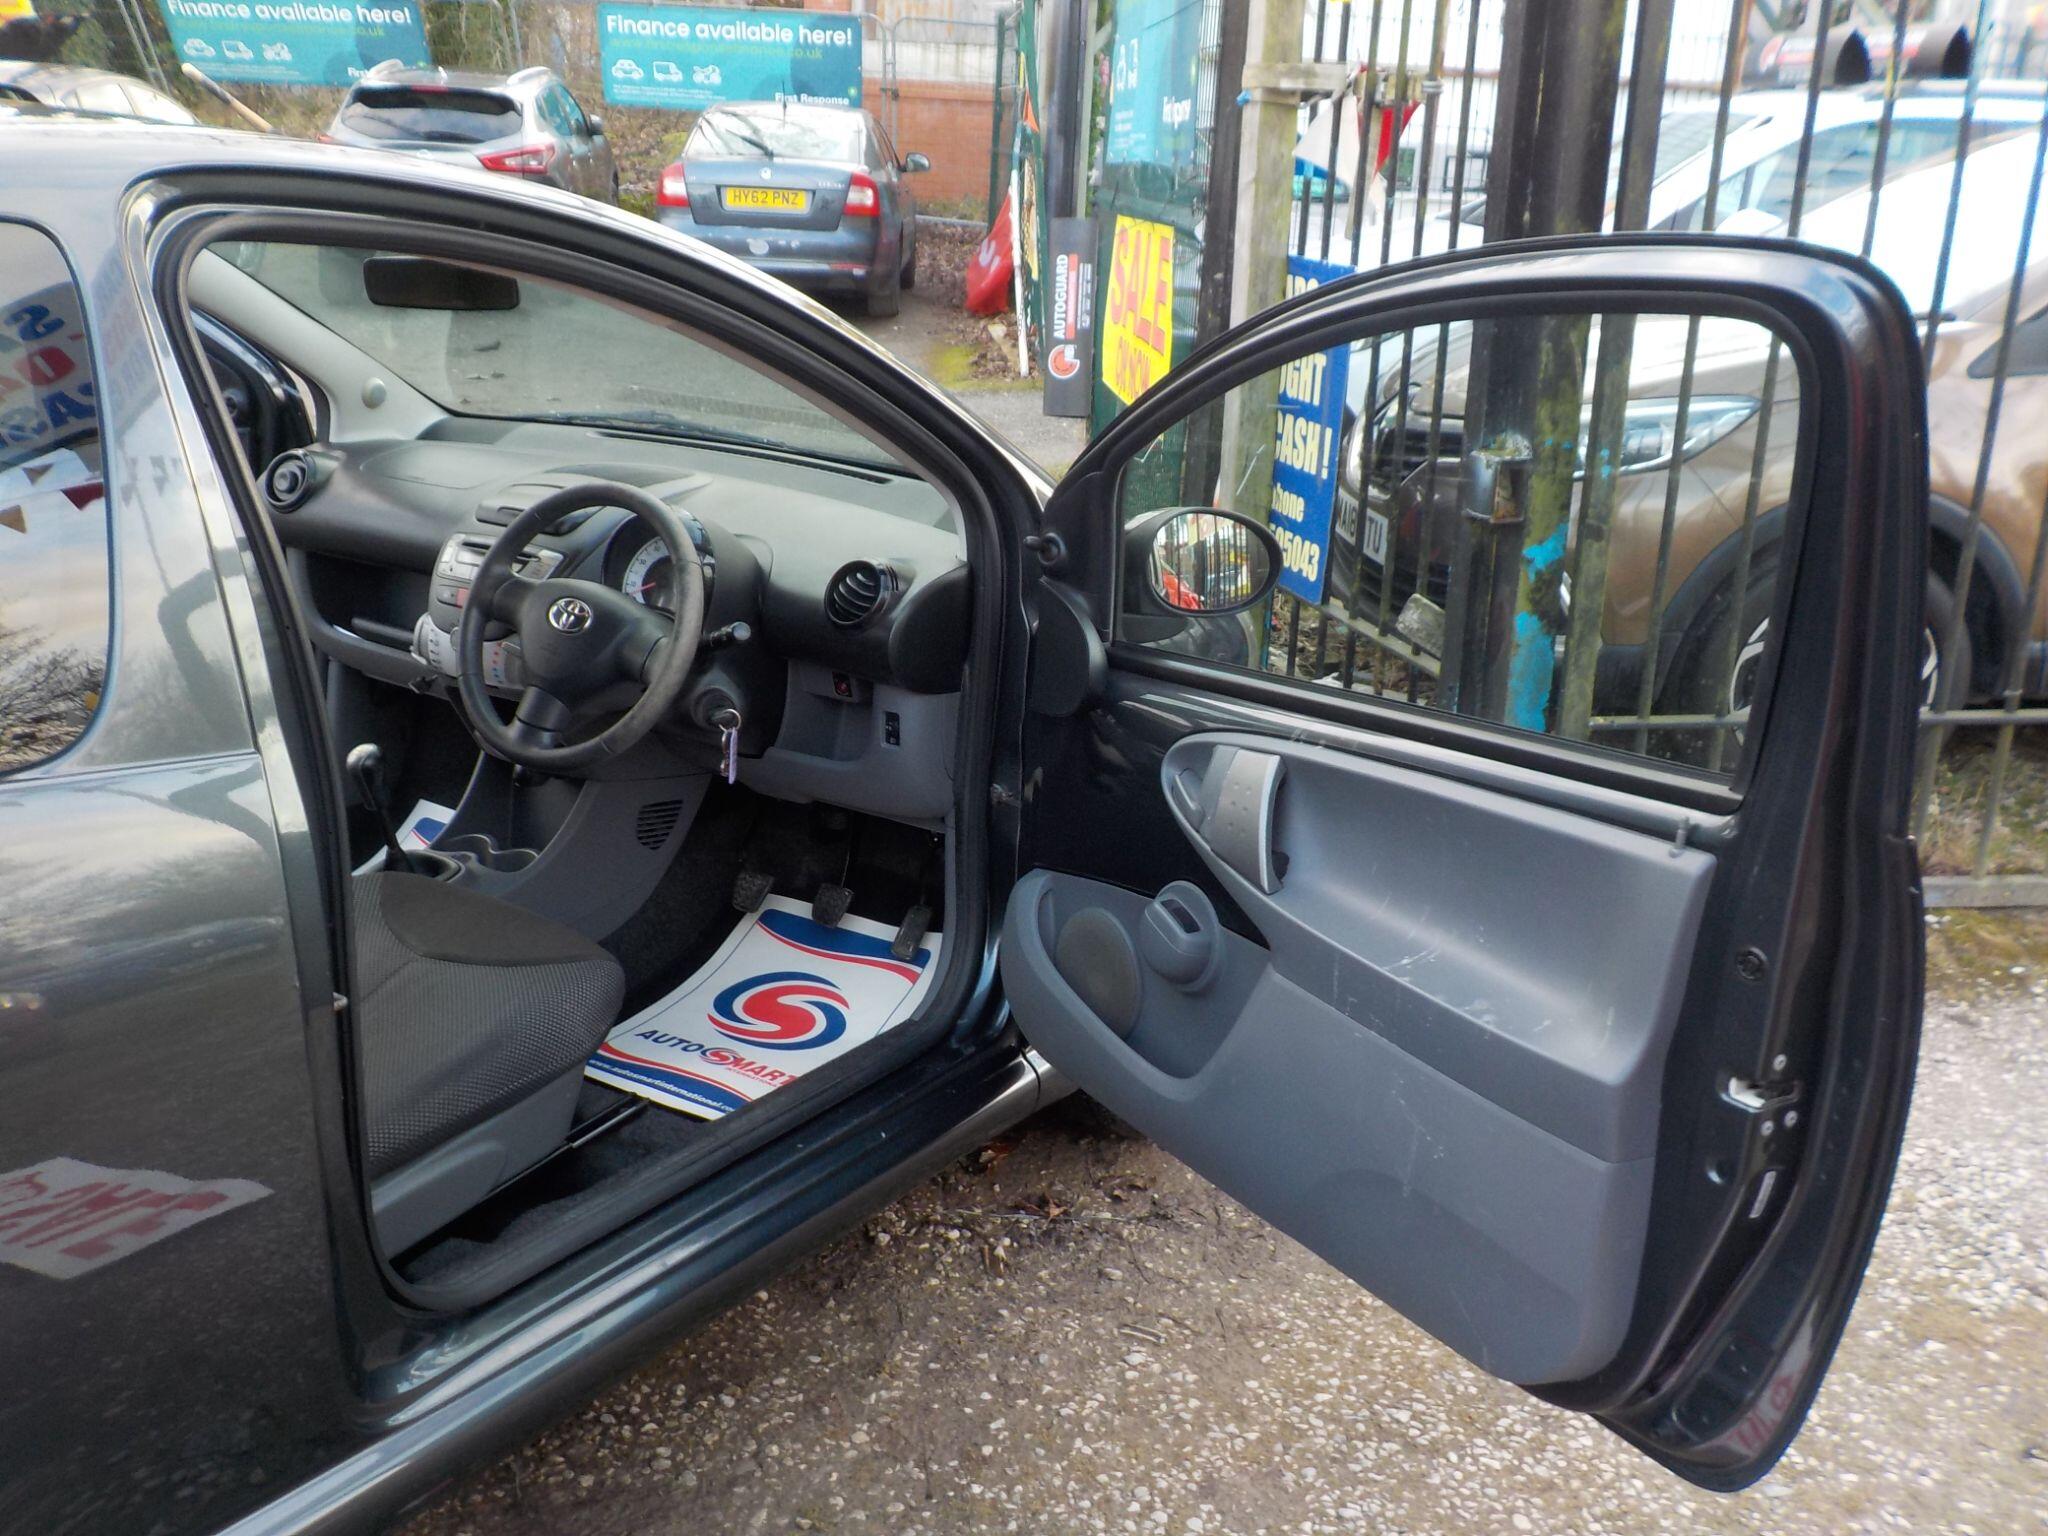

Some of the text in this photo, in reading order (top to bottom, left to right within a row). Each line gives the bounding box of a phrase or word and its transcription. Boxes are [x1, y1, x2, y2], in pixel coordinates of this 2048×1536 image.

[168, 0, 411, 24] Finance available here!
[607, 15, 852, 46] Finance available here!
[800, 94, 849, 106] Response
[733, 190, 799, 206] HY62 PNZ
[1053, 253, 1069, 340] AUTOGUARD
[1110, 226, 1170, 357] SALE
